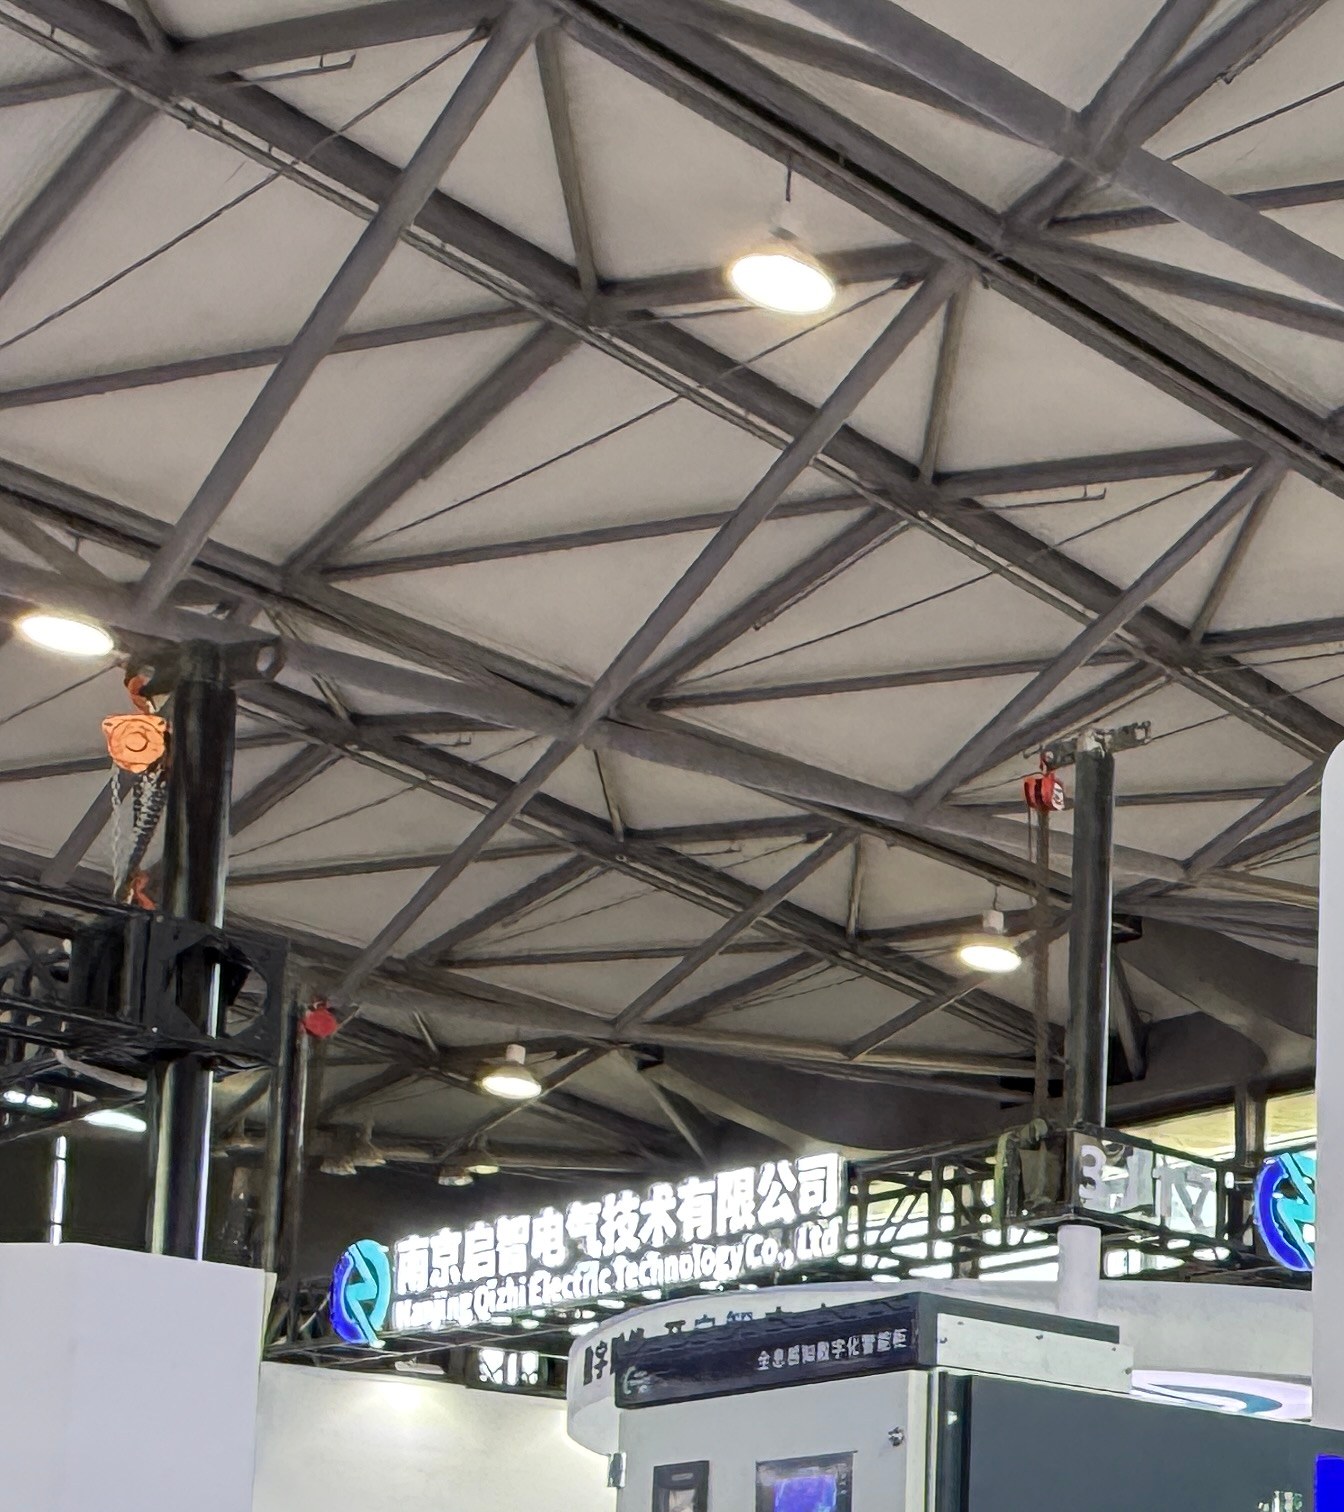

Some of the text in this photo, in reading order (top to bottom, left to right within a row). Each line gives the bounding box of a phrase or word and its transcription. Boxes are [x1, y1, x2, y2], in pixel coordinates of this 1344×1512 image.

[396, 1153, 842, 1294] 南京启智电气技术有限公司
